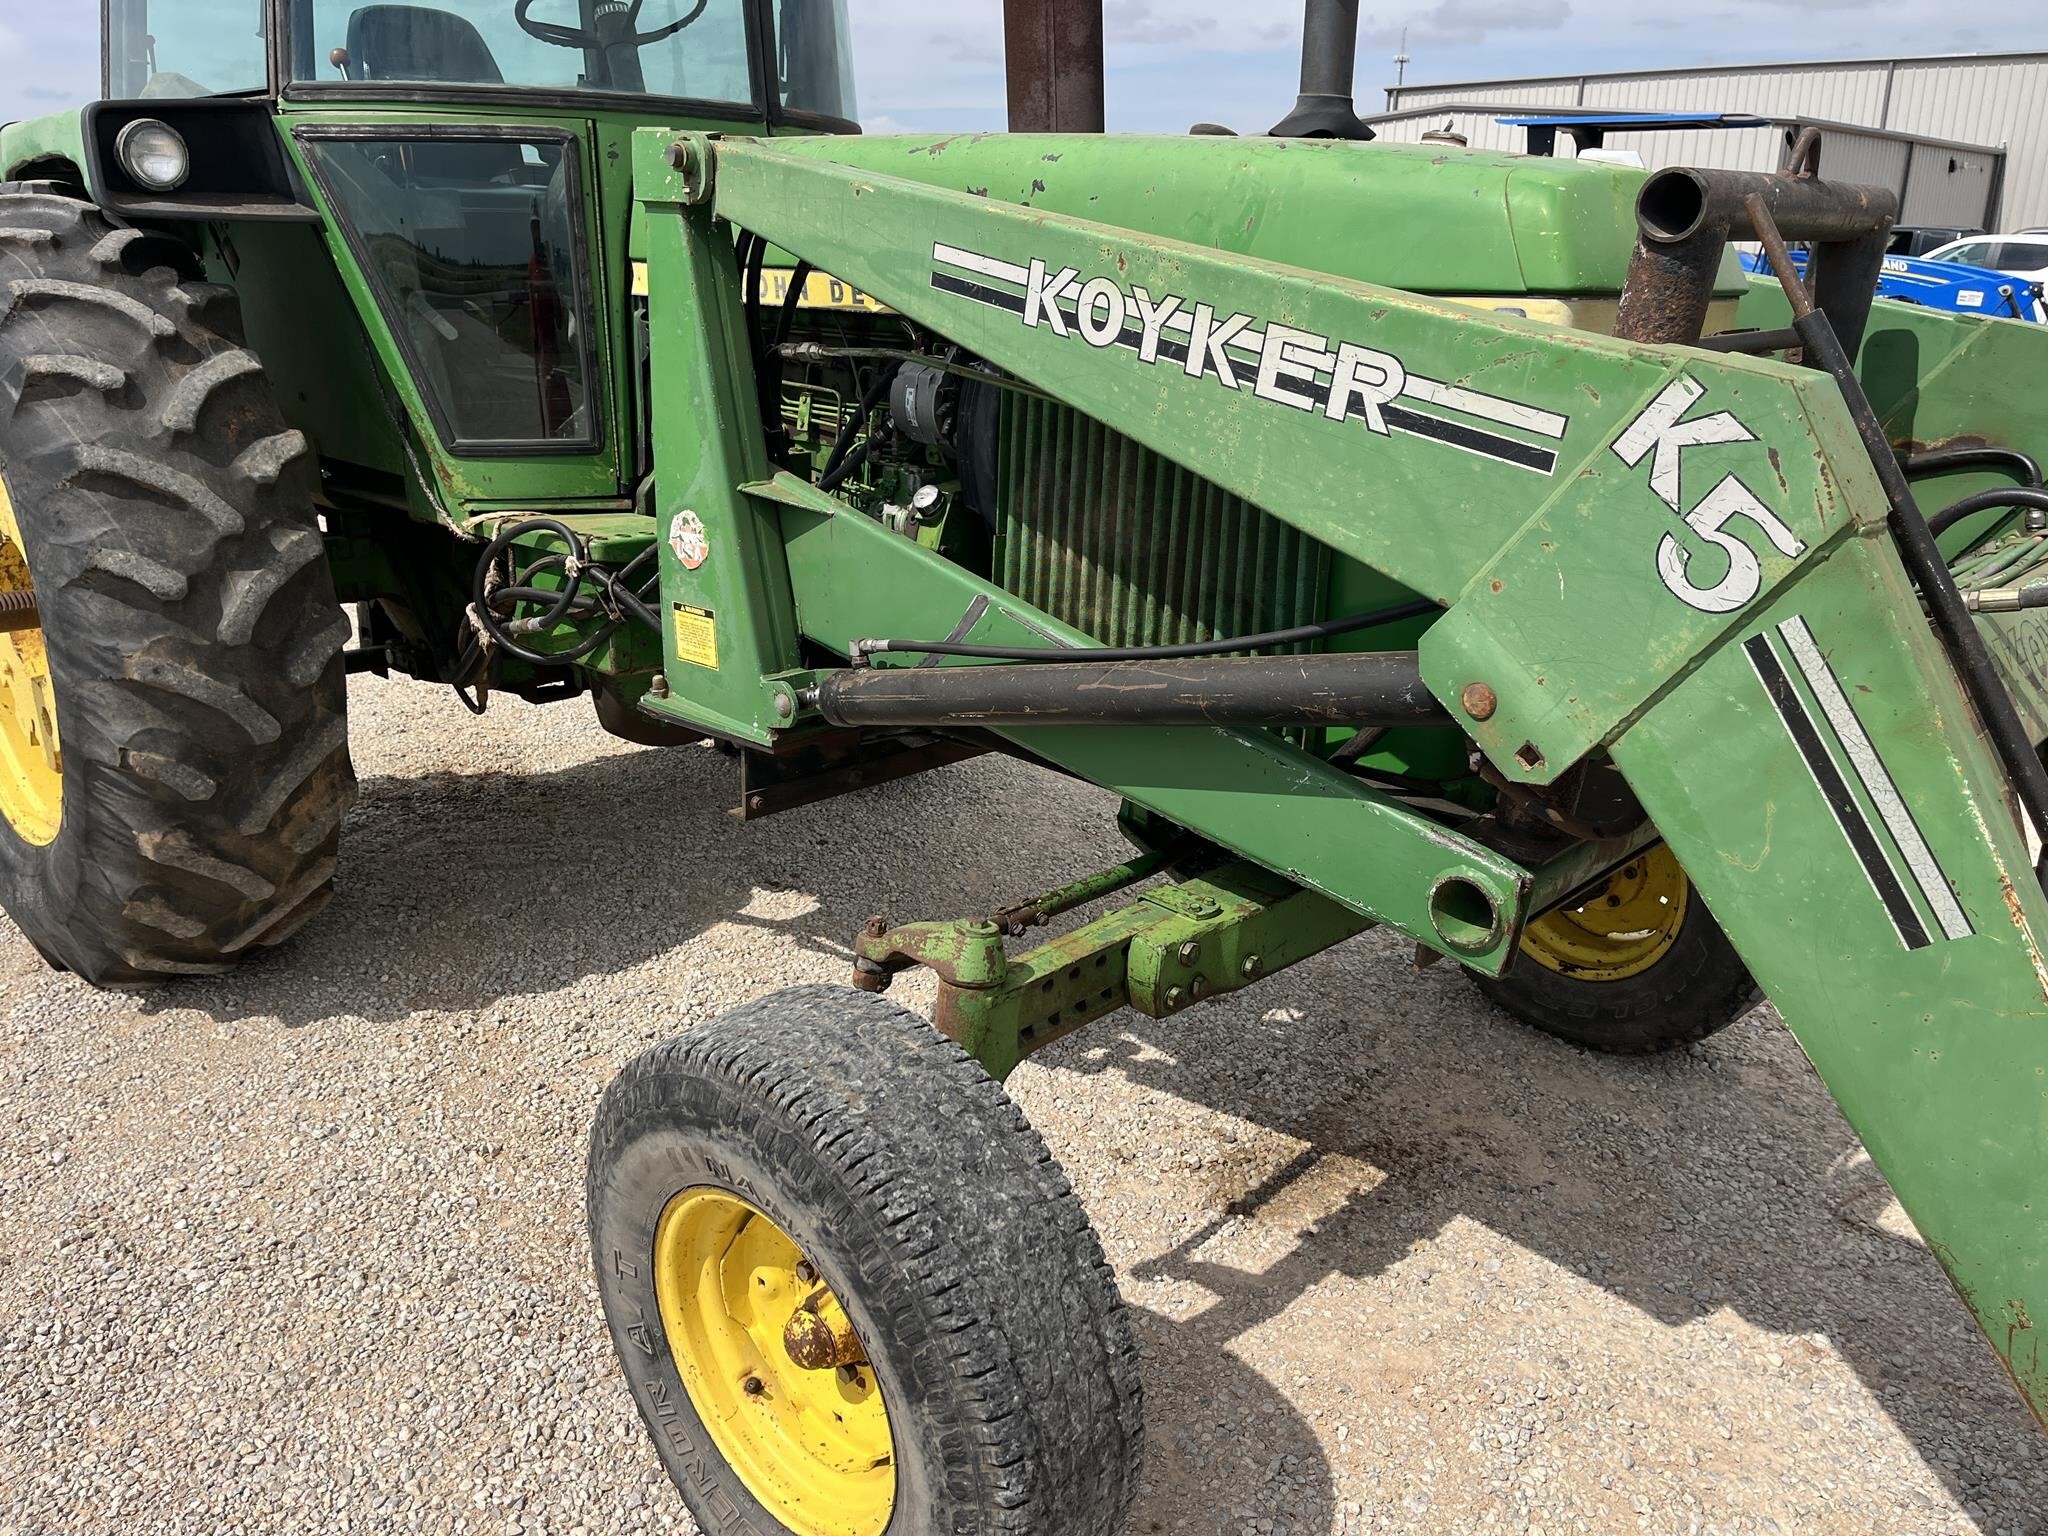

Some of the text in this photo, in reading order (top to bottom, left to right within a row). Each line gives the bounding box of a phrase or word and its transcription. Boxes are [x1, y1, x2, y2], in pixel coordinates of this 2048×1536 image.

[829, 279, 882, 305] DE
[1021, 256, 1407, 438] KOYKER
[1609, 368, 1808, 614] K5
